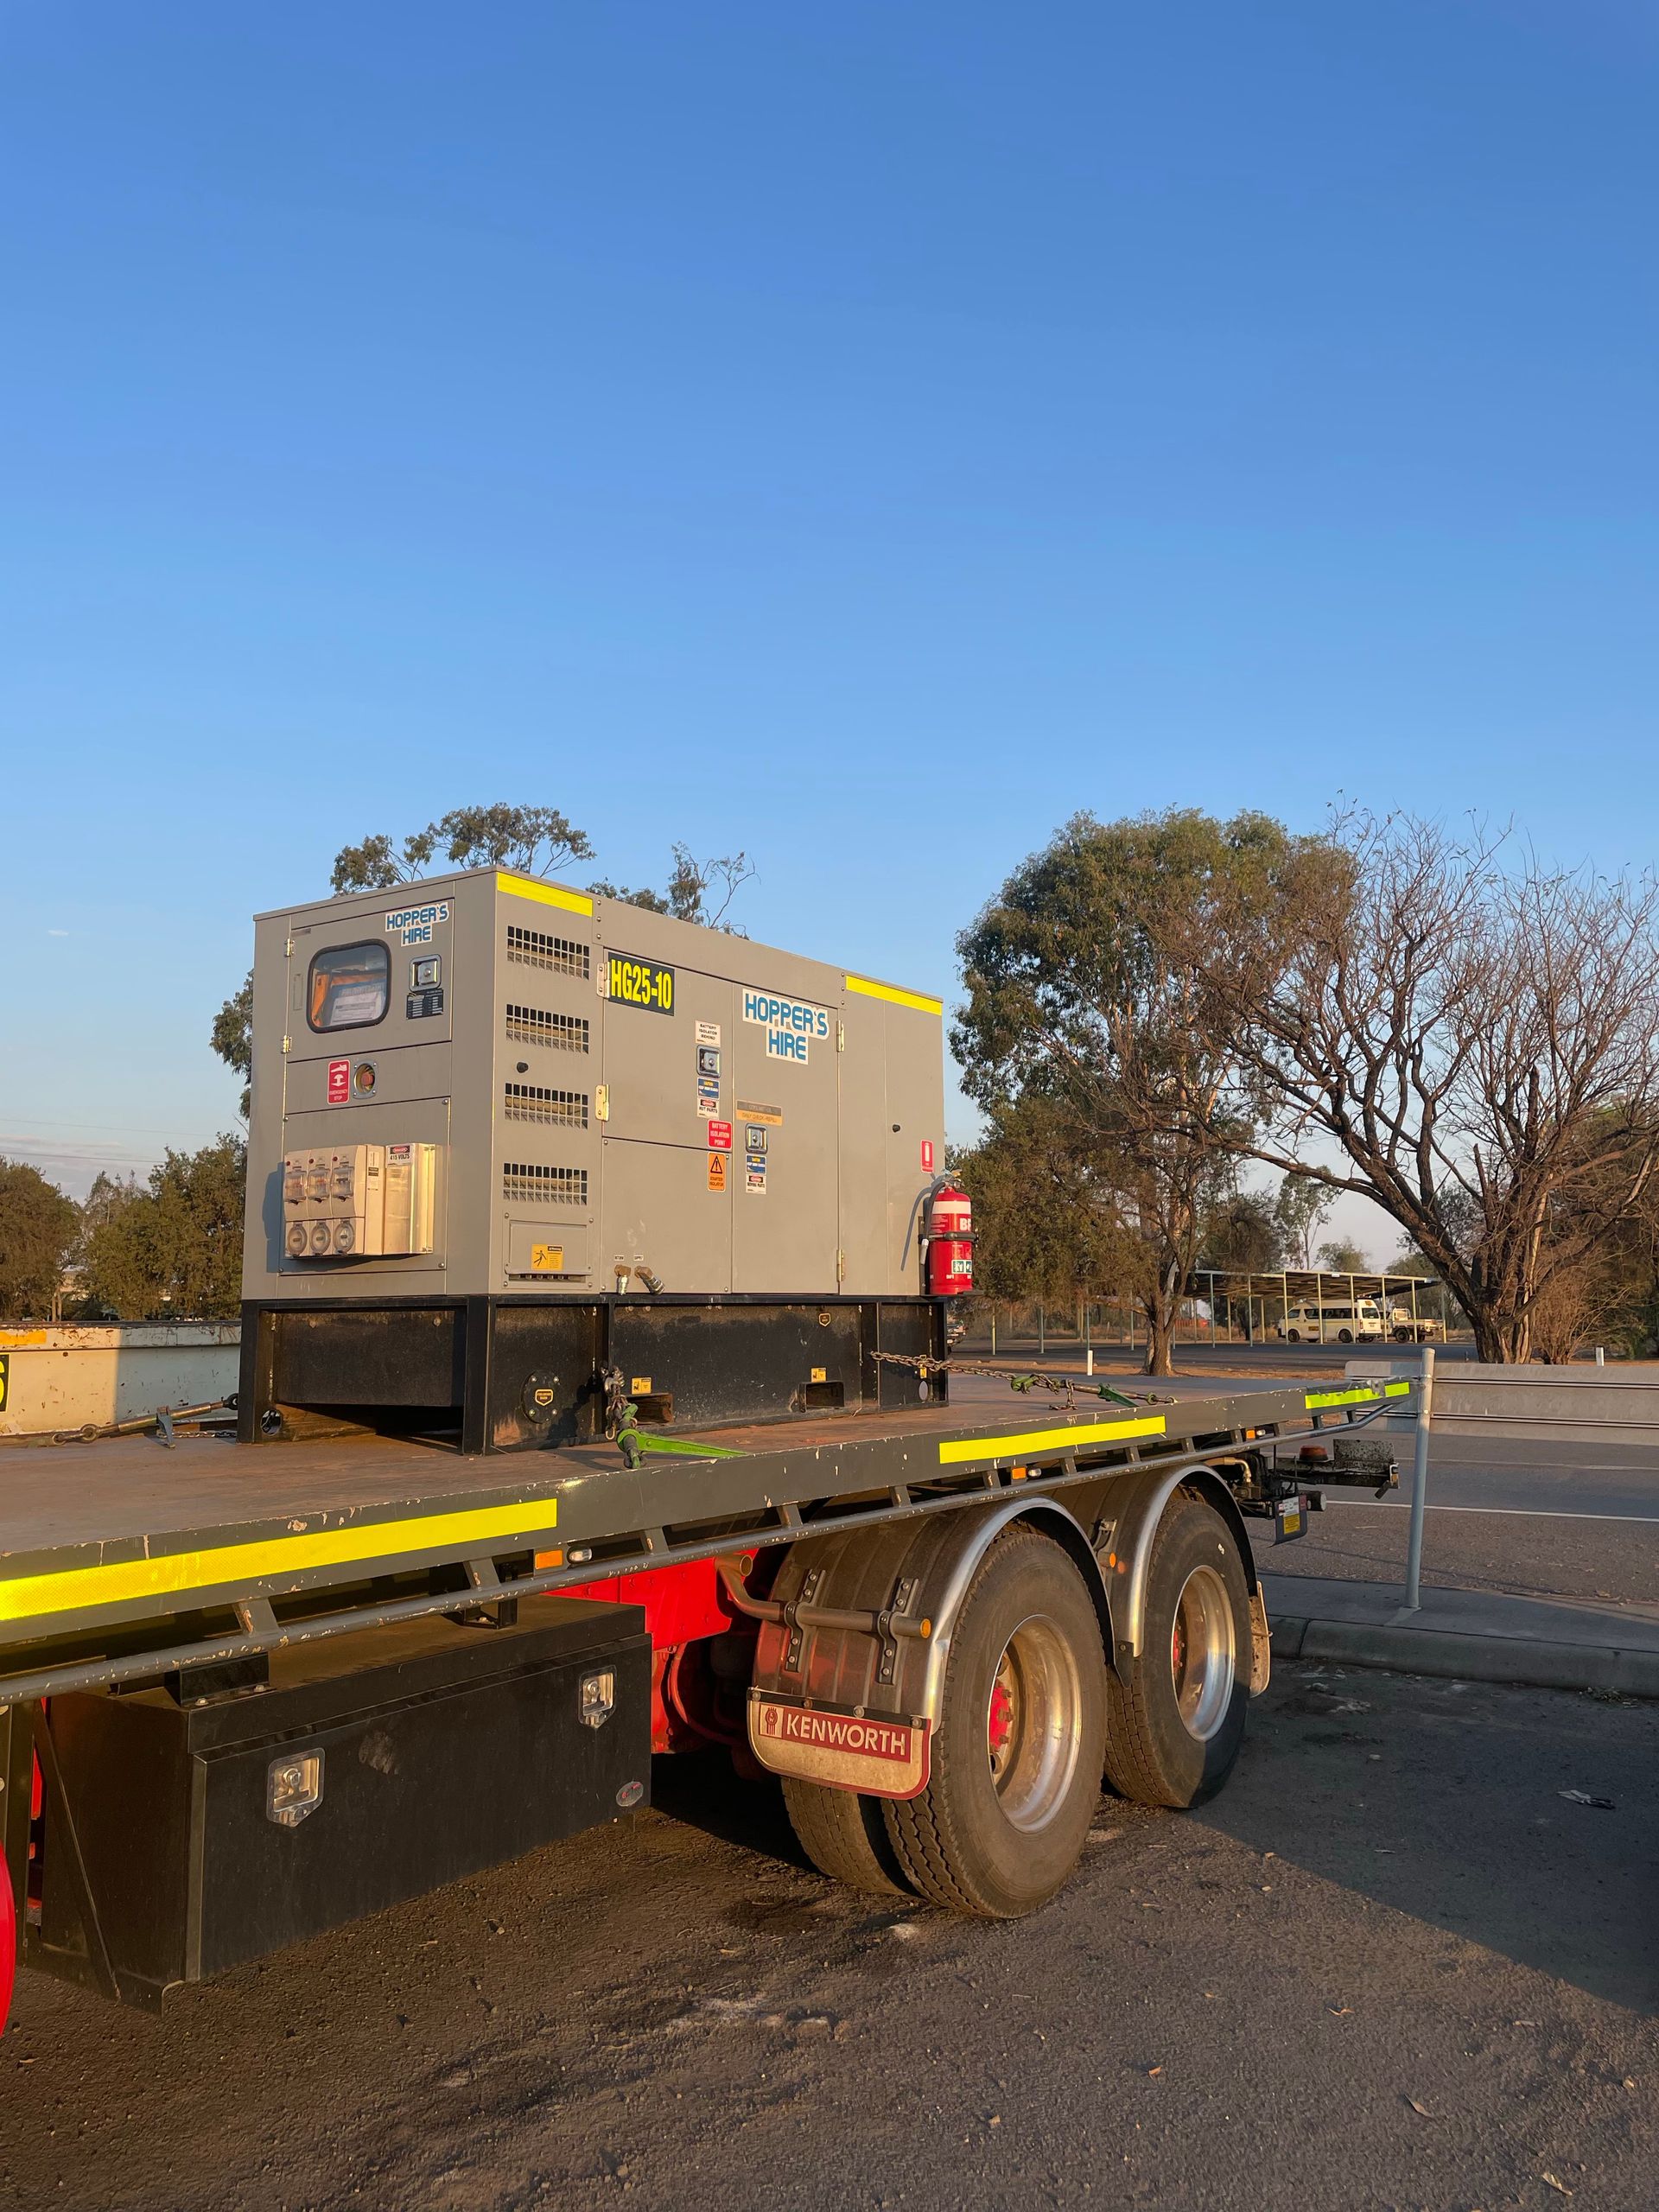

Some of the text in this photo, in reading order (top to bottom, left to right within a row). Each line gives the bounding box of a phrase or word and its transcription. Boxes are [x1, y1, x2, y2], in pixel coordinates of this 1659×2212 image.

[386, 904, 448, 930] HOPPER'S
[403, 925, 431, 945] HIRE
[611, 958, 672, 1010] HG25-10
[745, 993, 828, 1036] HOPPER'S
[768, 1028, 806, 1061] HIRE
[709, 1129, 730, 1139] ISOLATION
[711, 1122, 728, 1130] BATTERY
[714, 1139, 726, 1147] POINT
[786, 1713, 906, 1756] KENWORTH
